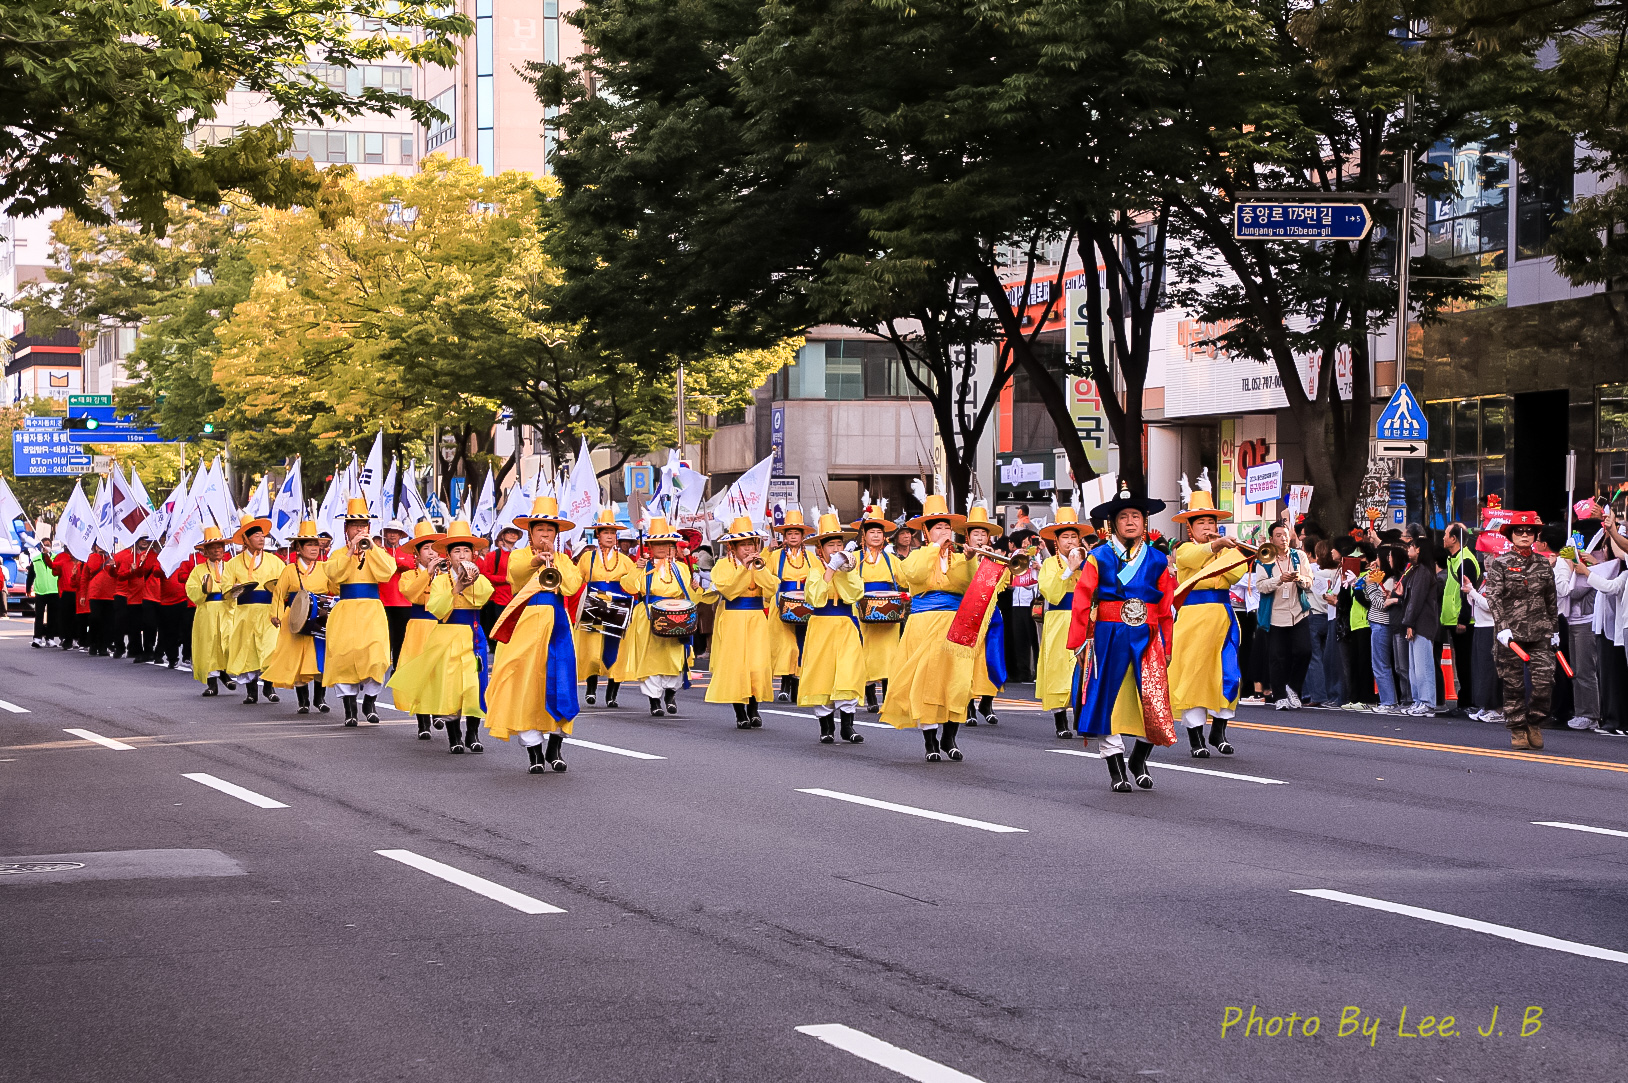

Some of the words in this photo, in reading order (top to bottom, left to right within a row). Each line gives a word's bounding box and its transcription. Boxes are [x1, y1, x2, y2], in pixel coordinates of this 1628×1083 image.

[1241, 207, 1283, 224] 중앙로
[1288, 207, 1332, 225] 175번길
[1241, 226, 1284, 236] Jungang-ro
[1287, 226, 1331, 236] 175beon-gil
[15, 432, 50, 443] 화물자동차
[1383, 428, 1420, 437] 횡단보도
[635, 472, 646, 488] B
